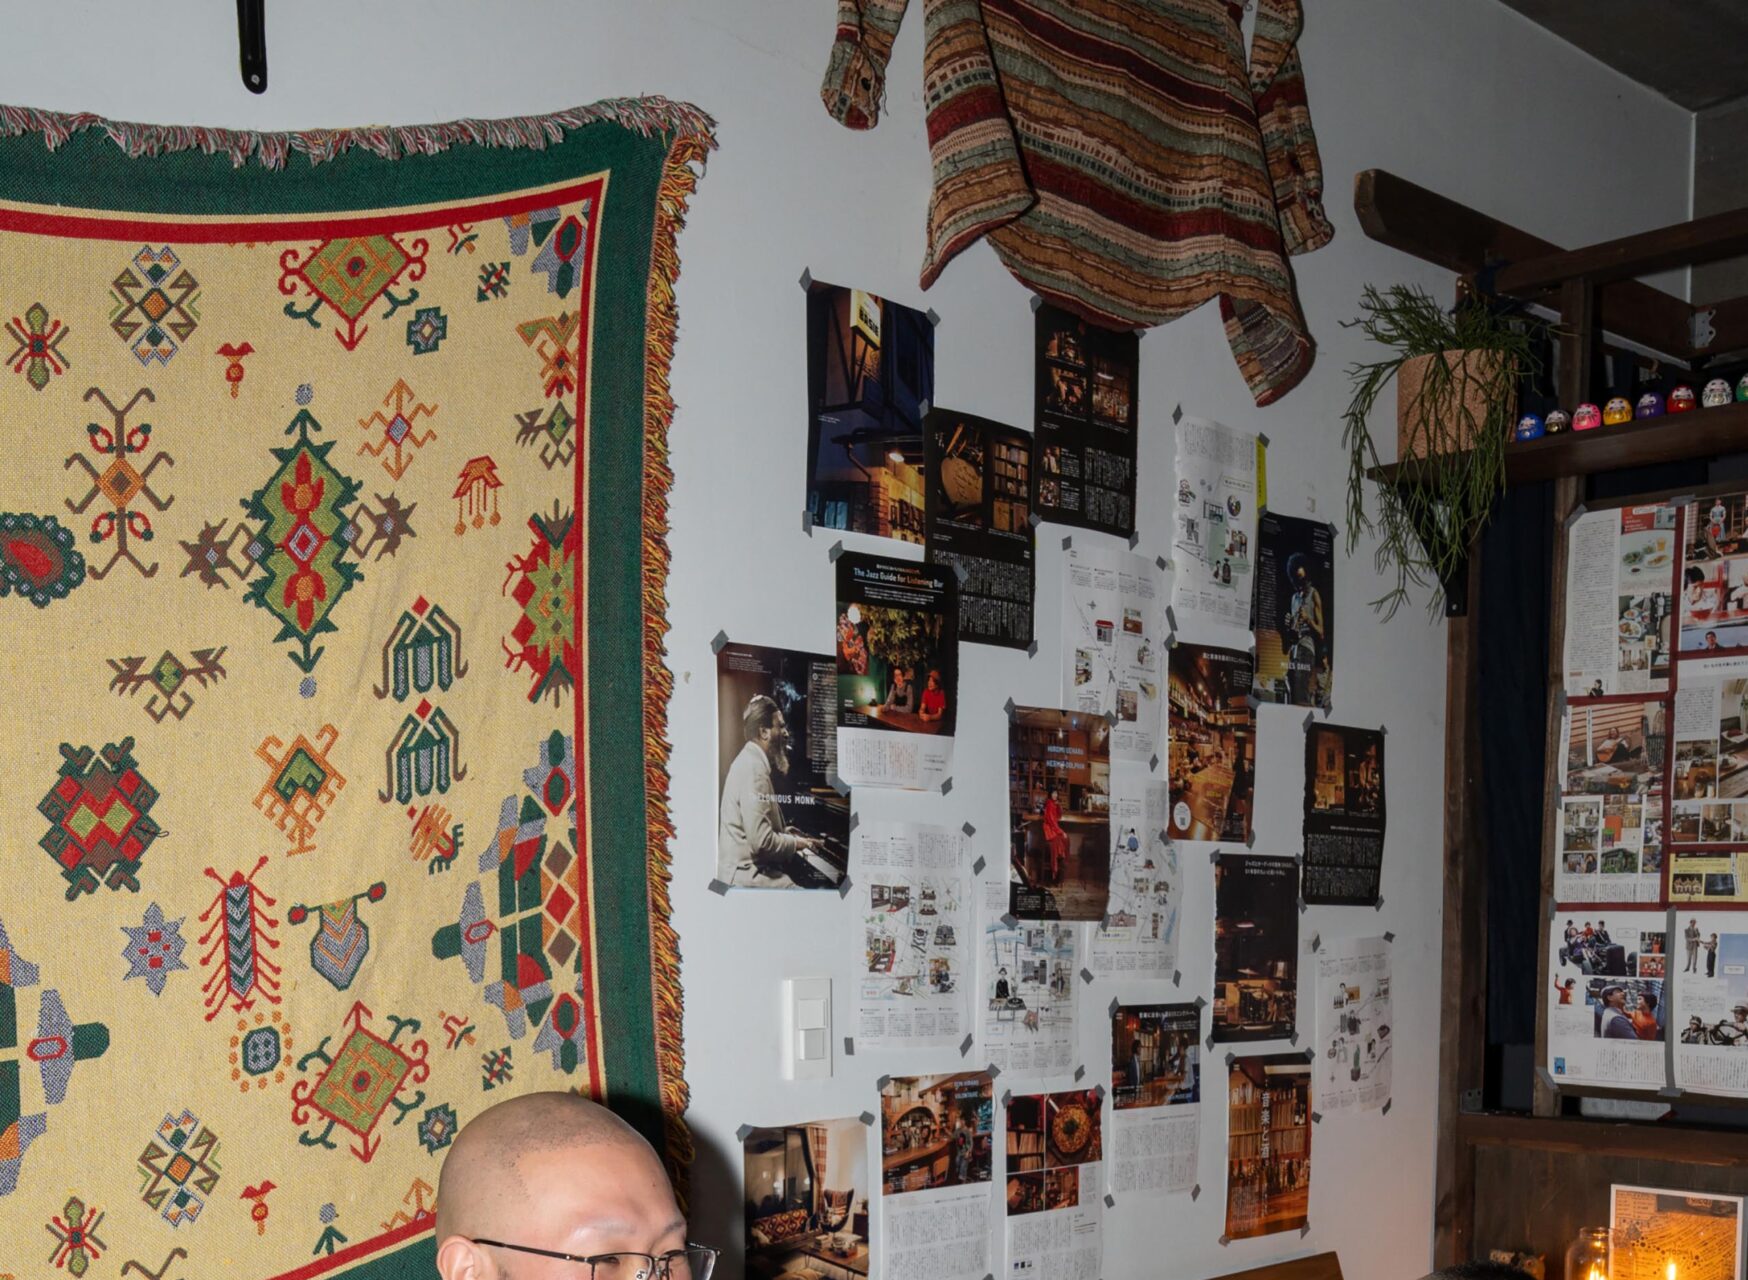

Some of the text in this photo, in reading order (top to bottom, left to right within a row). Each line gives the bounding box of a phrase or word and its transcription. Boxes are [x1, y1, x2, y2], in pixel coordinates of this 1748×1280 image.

[854, 567, 944, 588] The Jazz Guide for Listening Bar
[749, 792, 816, 805] ELONIOUS MONK
